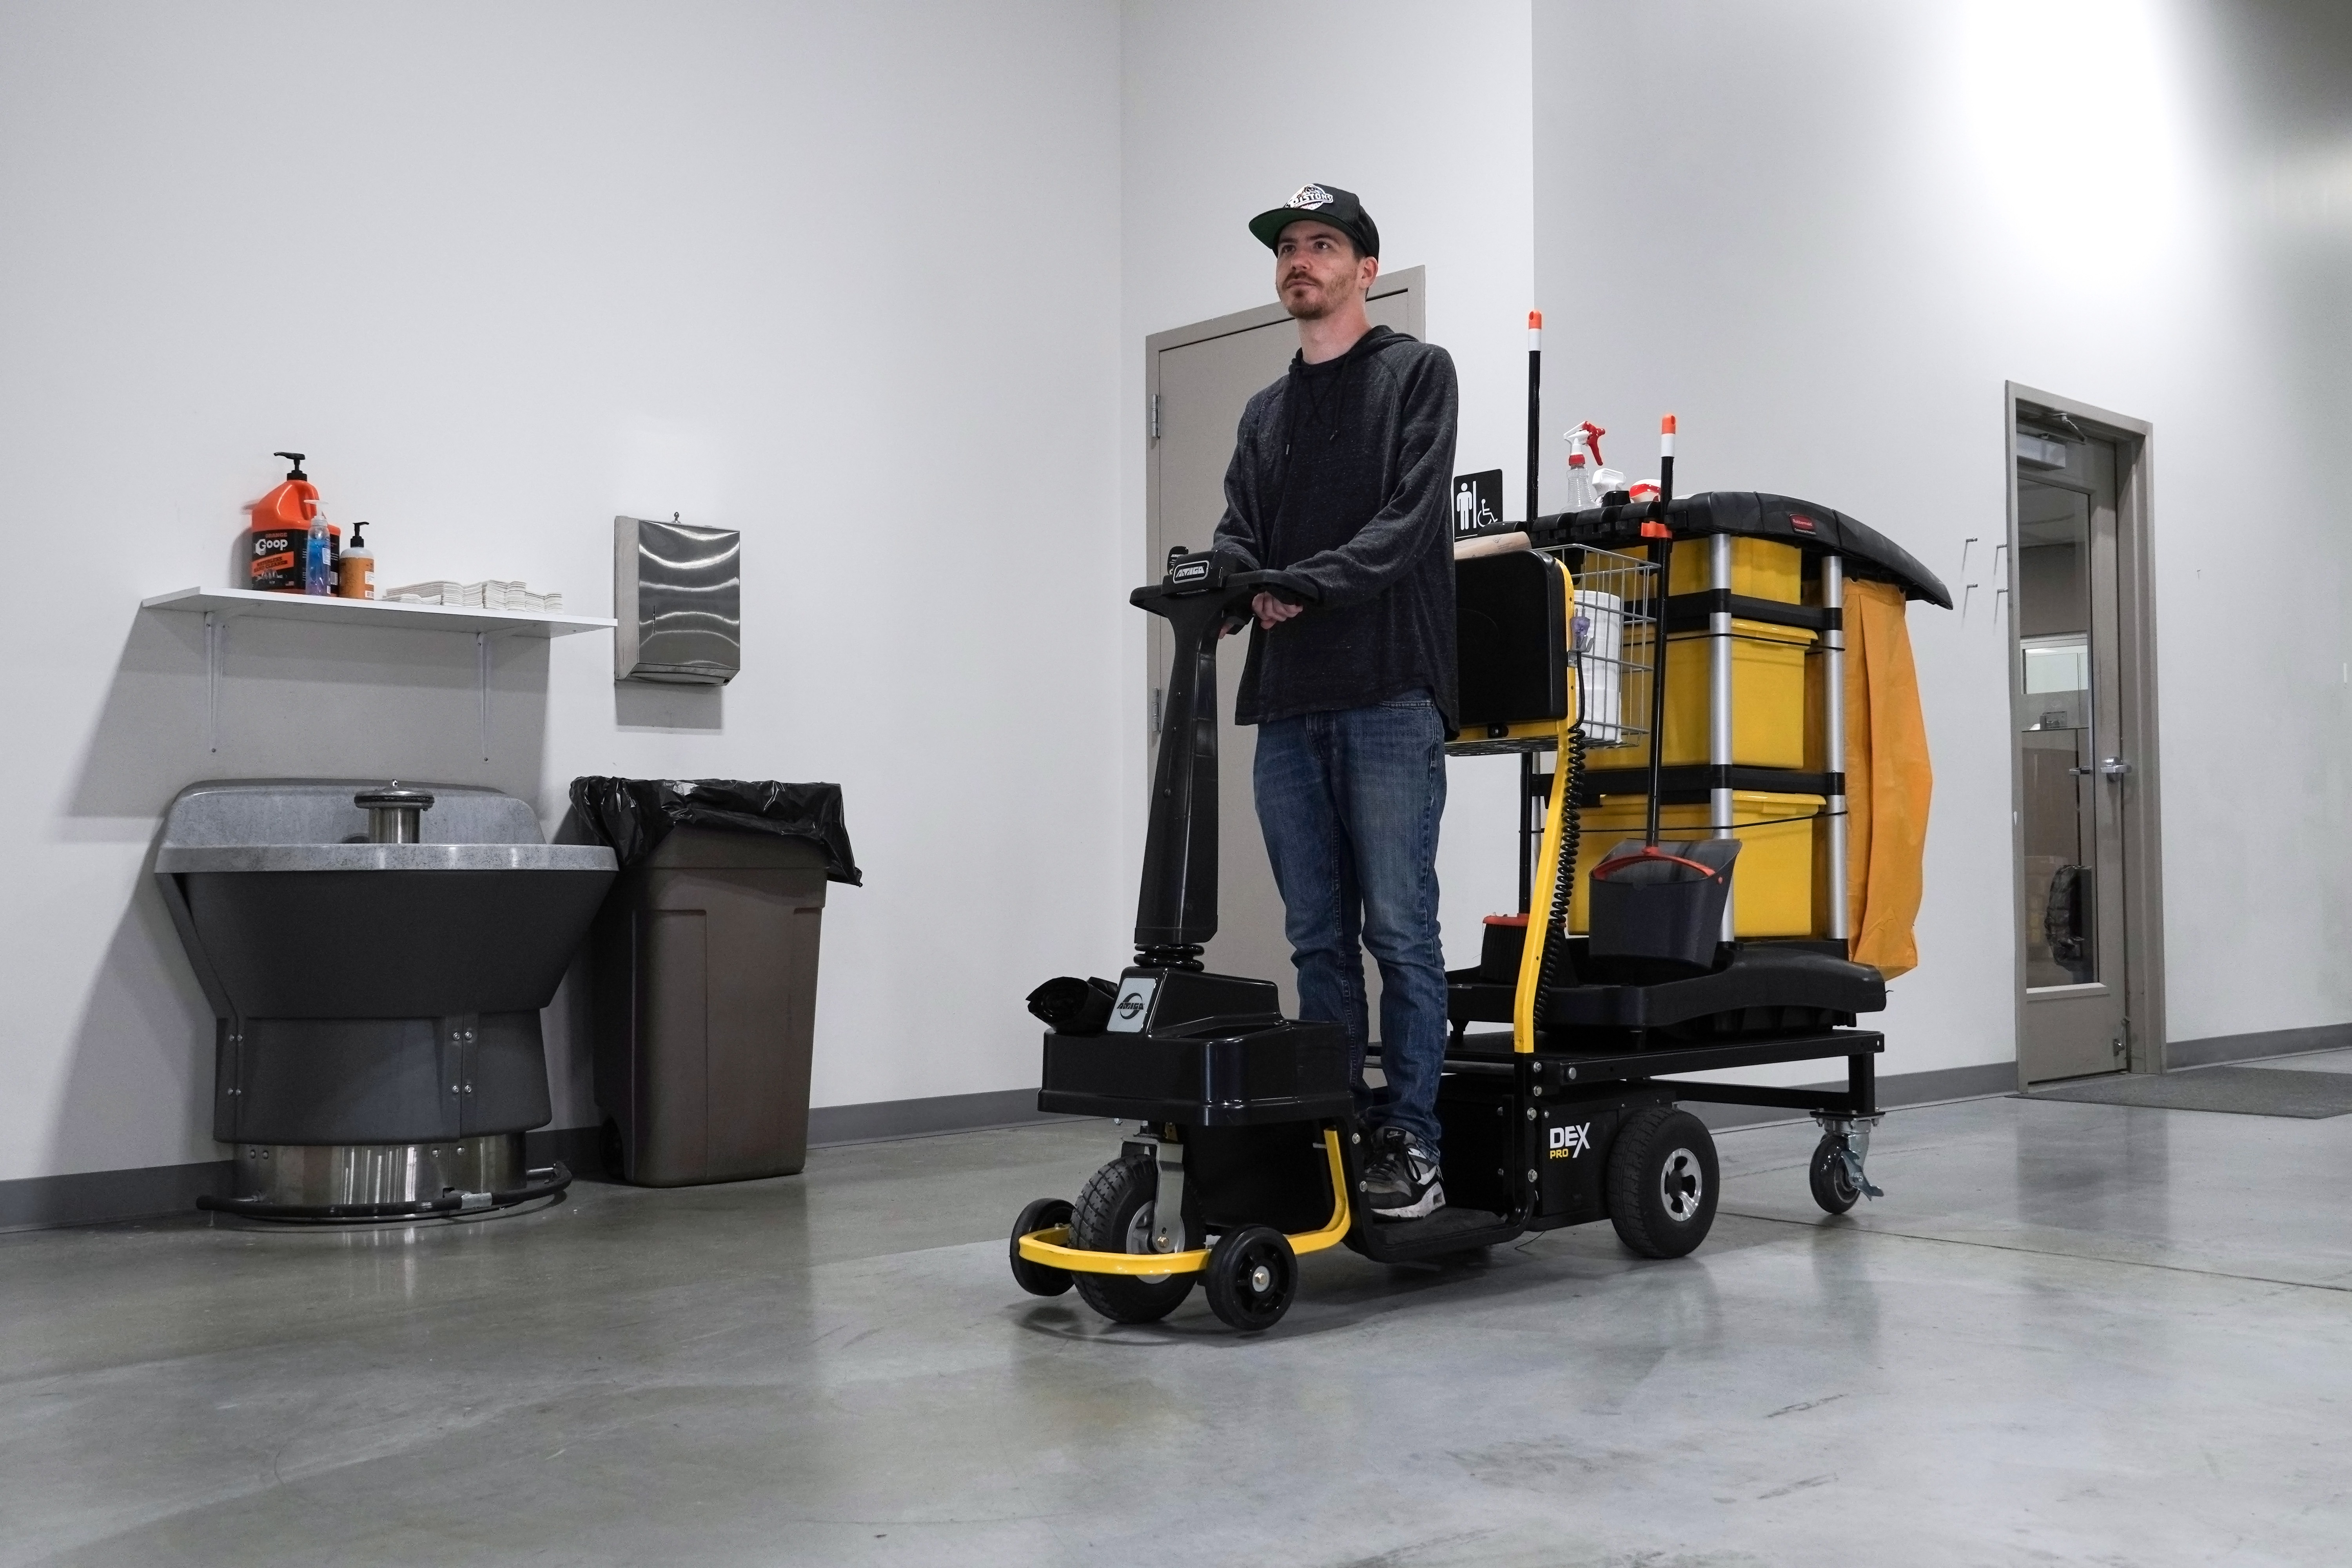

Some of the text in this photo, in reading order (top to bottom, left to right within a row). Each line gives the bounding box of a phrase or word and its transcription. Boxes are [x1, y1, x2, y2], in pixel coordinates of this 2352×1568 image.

[1288, 193, 1332, 208] PISTONS
[256, 539, 288, 555] Goop
[1175, 566, 1204, 578] AMIGO
[1550, 1122, 1590, 1158] DEX
[1550, 1149, 1568, 1159] PRO
